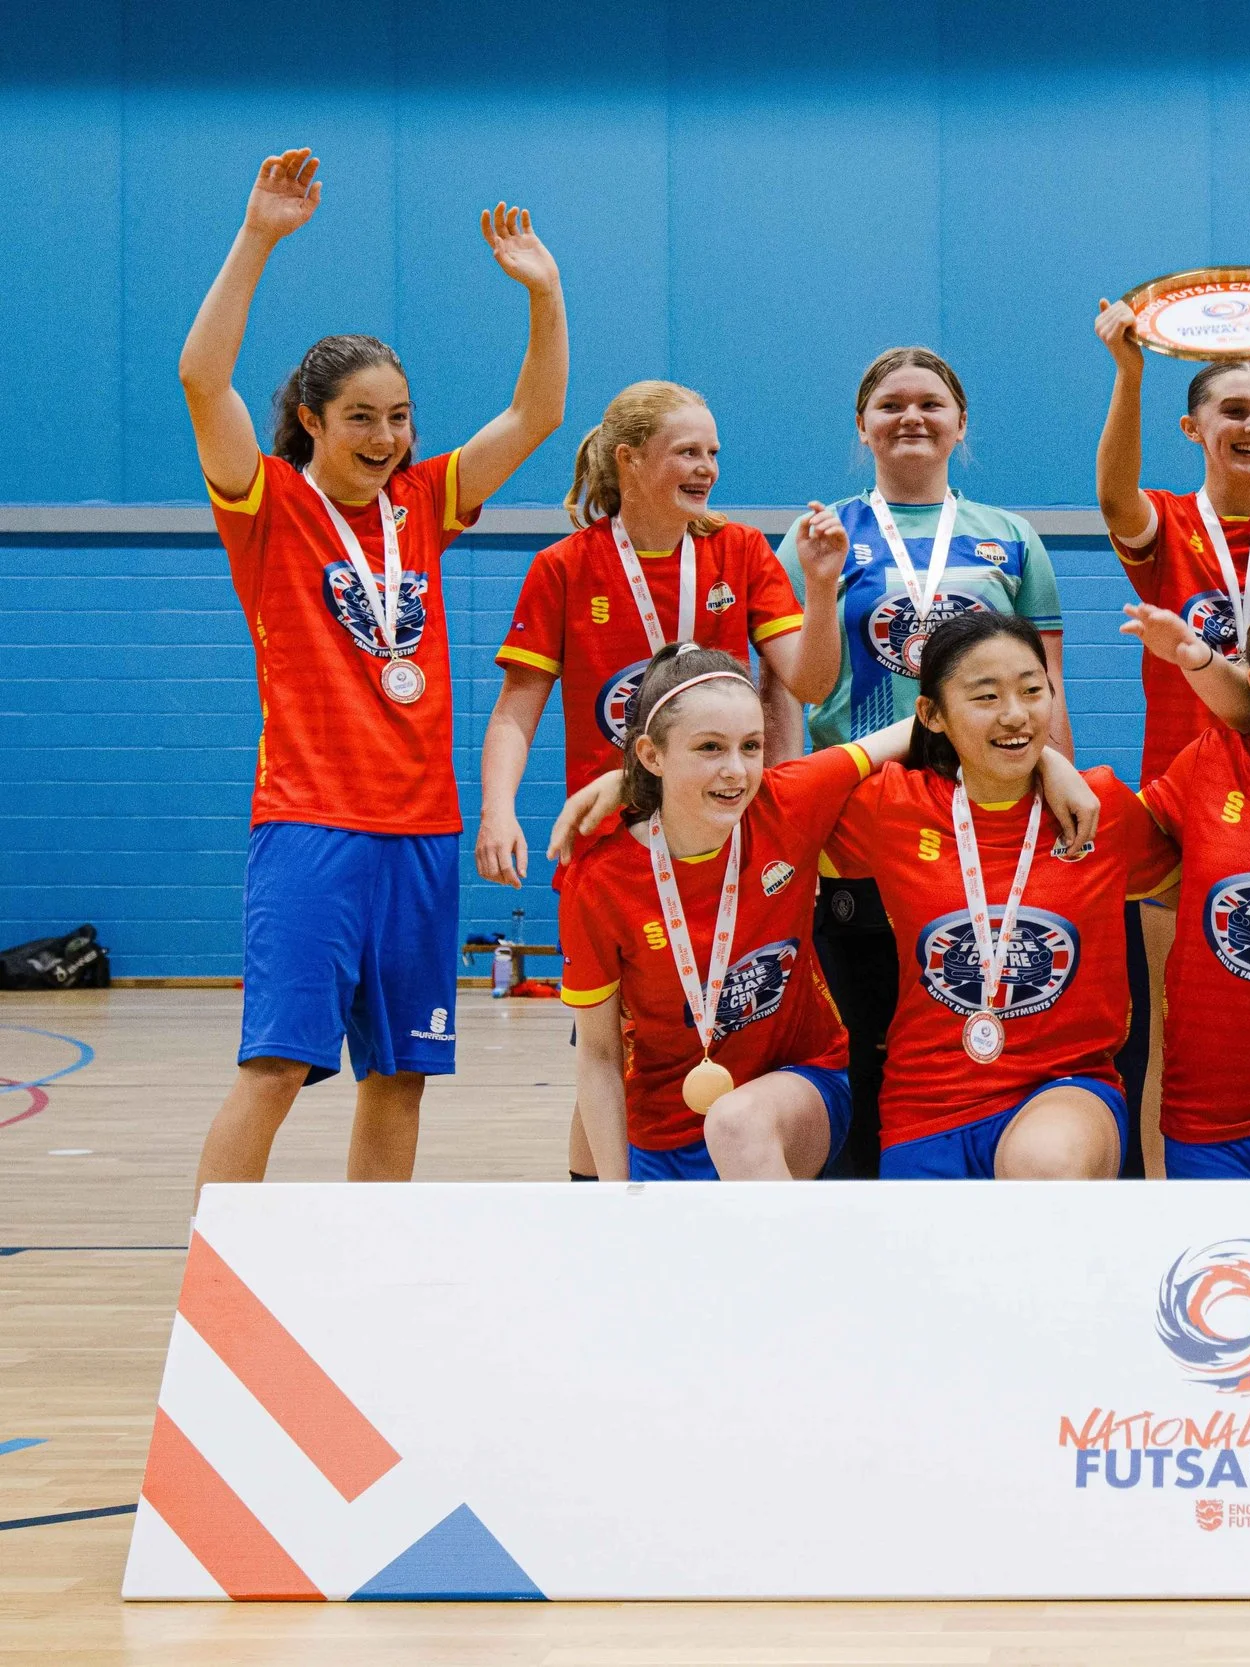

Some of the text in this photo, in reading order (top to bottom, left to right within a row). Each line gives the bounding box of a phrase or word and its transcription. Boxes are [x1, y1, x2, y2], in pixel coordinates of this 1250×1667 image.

[876, 655, 902, 673] BAILEY
[1215, 949, 1241, 974] BAILEY
[730, 965, 767, 983] THE
[927, 985, 954, 1007] BAILEY
[998, 1002, 1051, 1020] VESTMENTS
